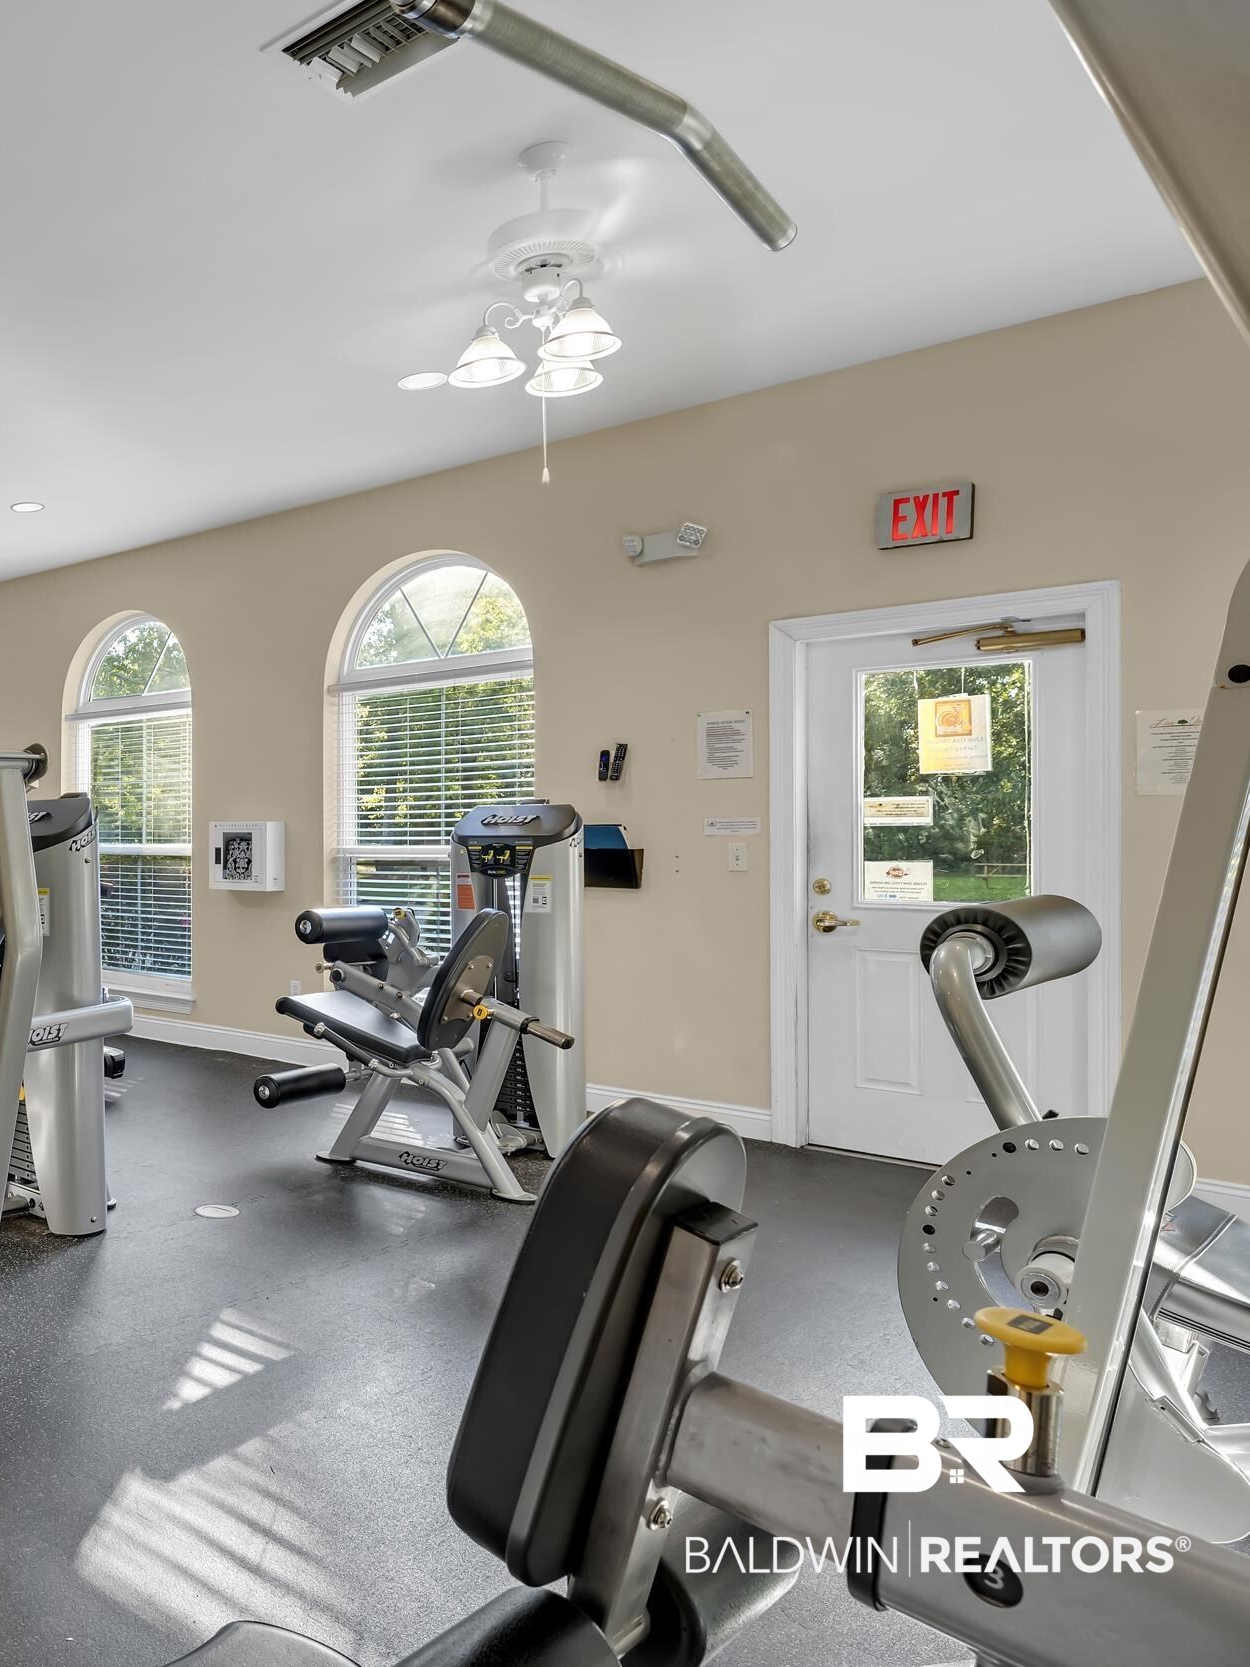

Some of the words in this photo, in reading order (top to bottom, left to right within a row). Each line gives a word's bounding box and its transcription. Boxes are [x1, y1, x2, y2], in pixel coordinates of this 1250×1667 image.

[891, 489, 960, 542] EXIT
[481, 814, 540, 826] HOIST
[398, 1151, 447, 1171] HOIST
